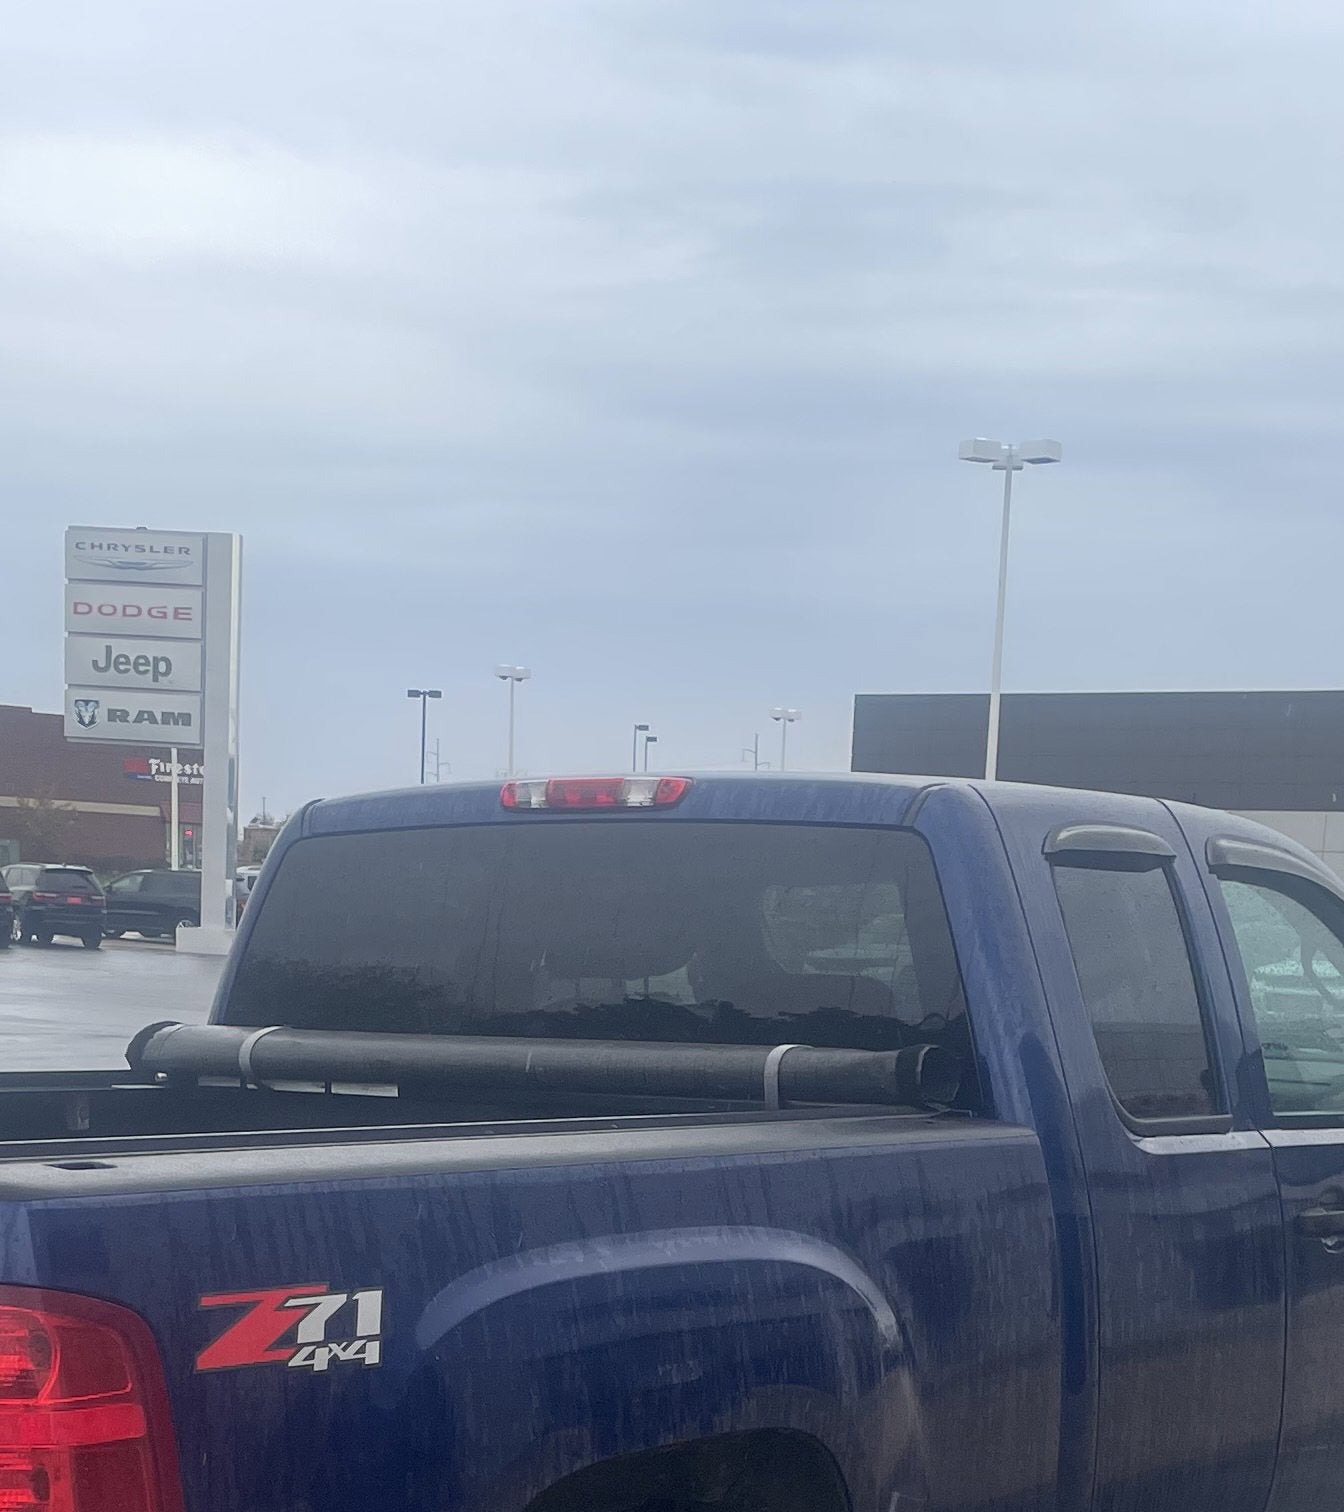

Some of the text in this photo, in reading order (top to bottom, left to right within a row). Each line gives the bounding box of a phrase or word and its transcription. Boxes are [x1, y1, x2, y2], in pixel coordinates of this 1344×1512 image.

[75, 541, 191, 556] CHRYSLER
[73, 601, 193, 621] DODGE
[92, 645, 173, 683] Jeep
[107, 708, 192, 727] RAM
[196, 1284, 383, 1370] Z71
